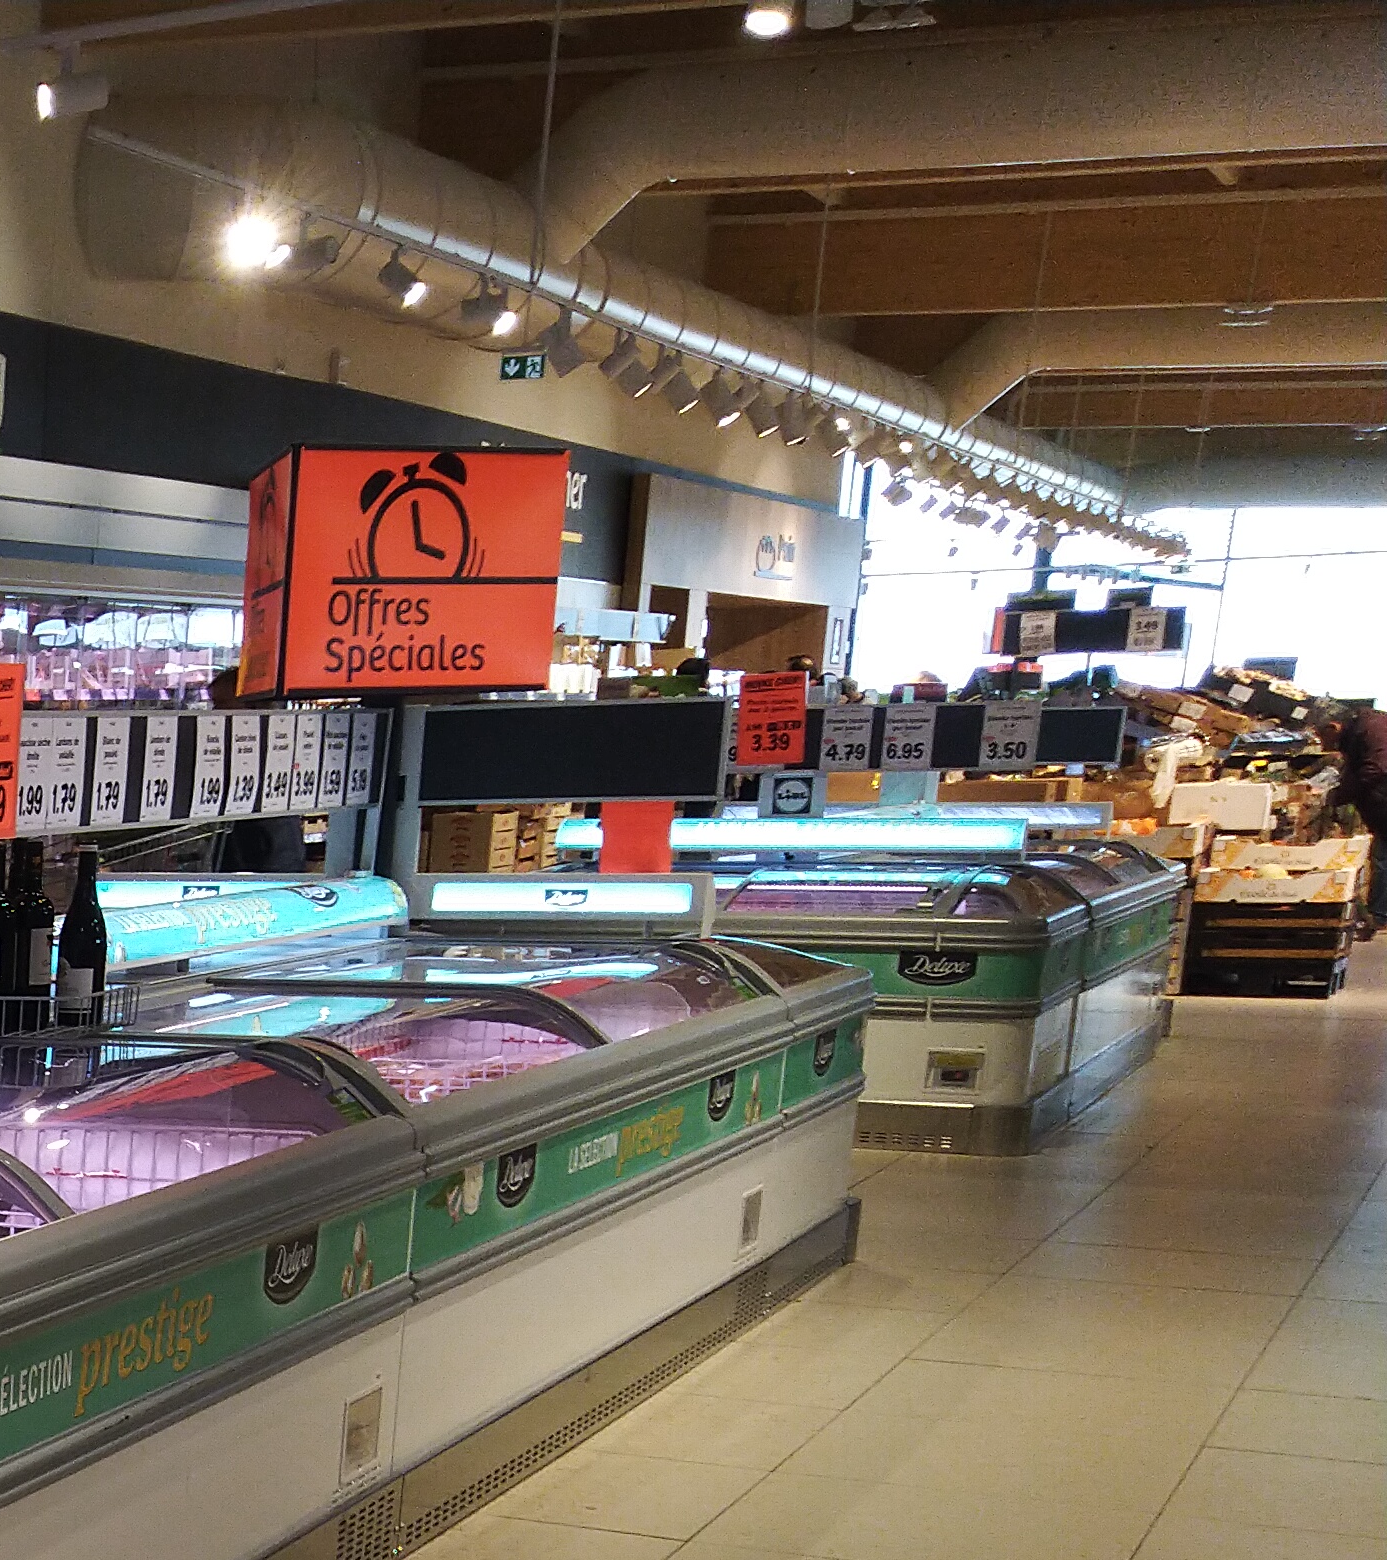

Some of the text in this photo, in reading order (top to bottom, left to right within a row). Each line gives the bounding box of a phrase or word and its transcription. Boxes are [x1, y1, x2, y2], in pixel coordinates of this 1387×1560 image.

[328, 588, 431, 636] Offres
[324, 631, 487, 683] Spéciales
[751, 732, 791, 753] 3.39
[825, 743, 867, 761] 4.79
[886, 742, 925, 760] 6.95
[986, 741, 1028, 760] 3.50
[18, 784, 43, 817] 1.99
[52, 782, 77, 815] 1.79
[96, 780, 120, 811] 1.79
[905, 954, 972, 977] Deluxe
[73, 1286, 215, 1419] prestige
